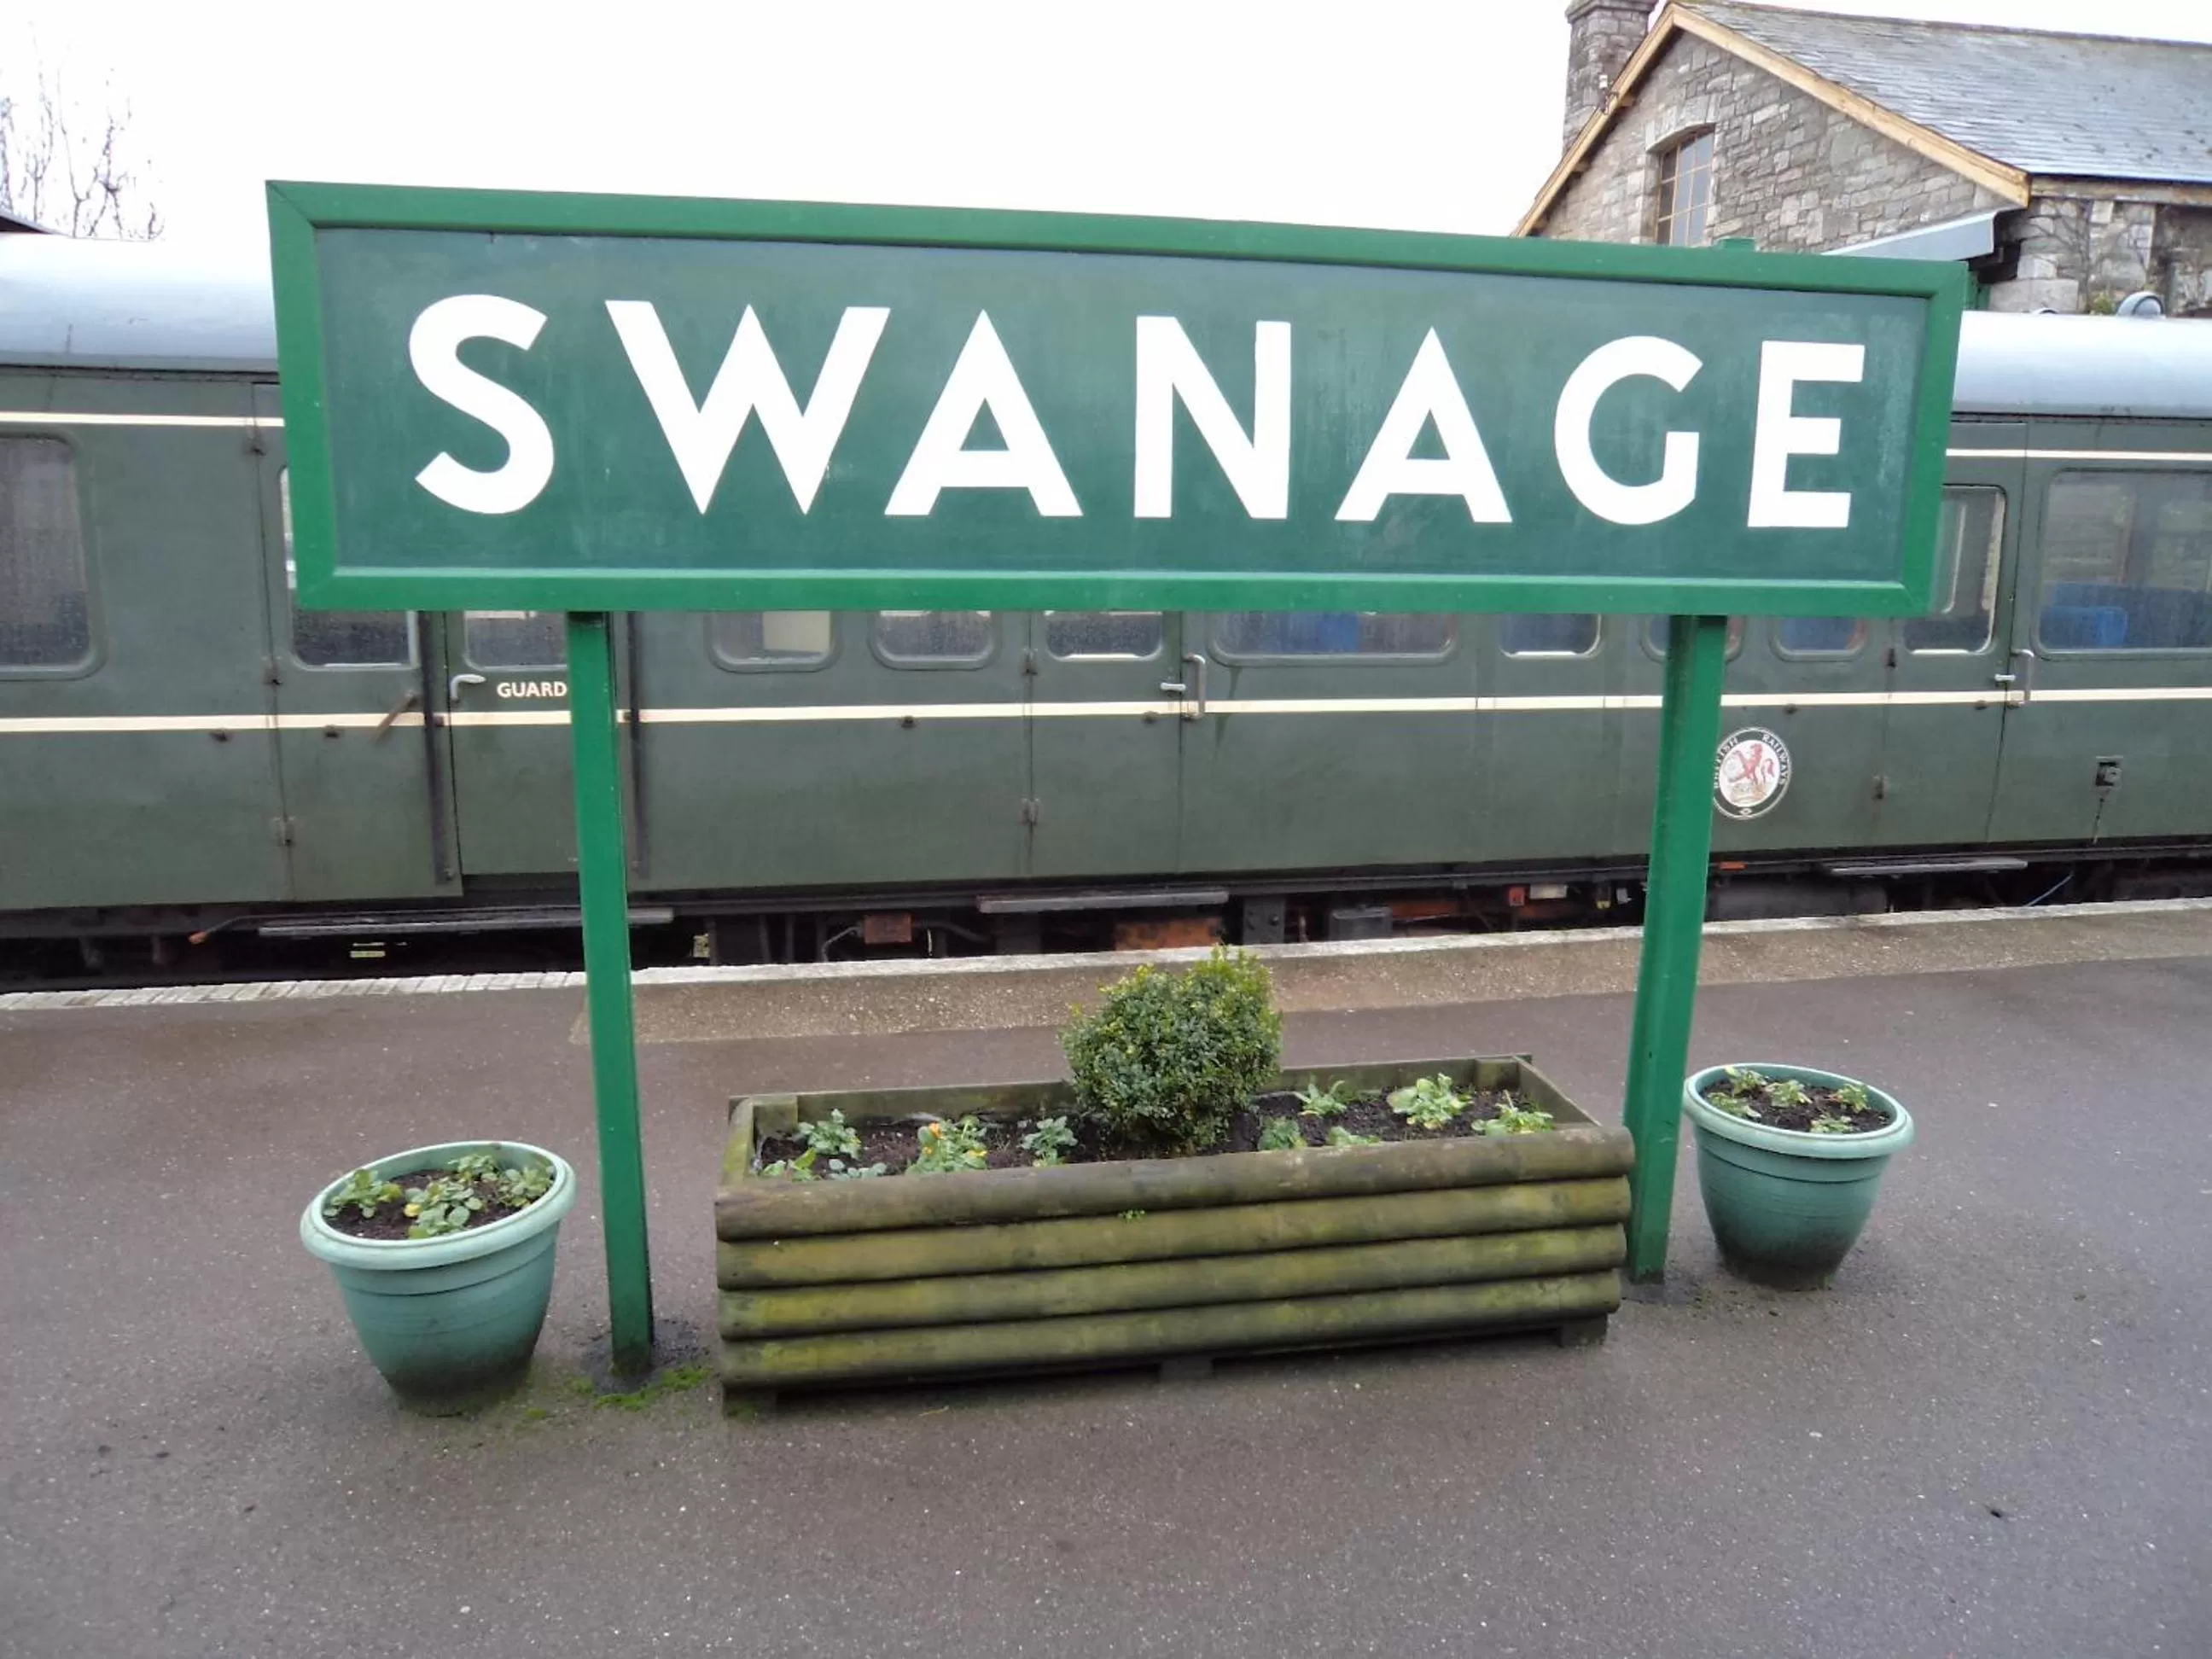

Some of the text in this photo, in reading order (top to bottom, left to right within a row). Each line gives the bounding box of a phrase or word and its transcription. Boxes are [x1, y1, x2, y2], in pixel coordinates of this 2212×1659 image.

[410, 294, 1866, 528] SWANAGE
[497, 681, 568, 698] GUARD
[1761, 734, 1790, 785] RAILWAYS
